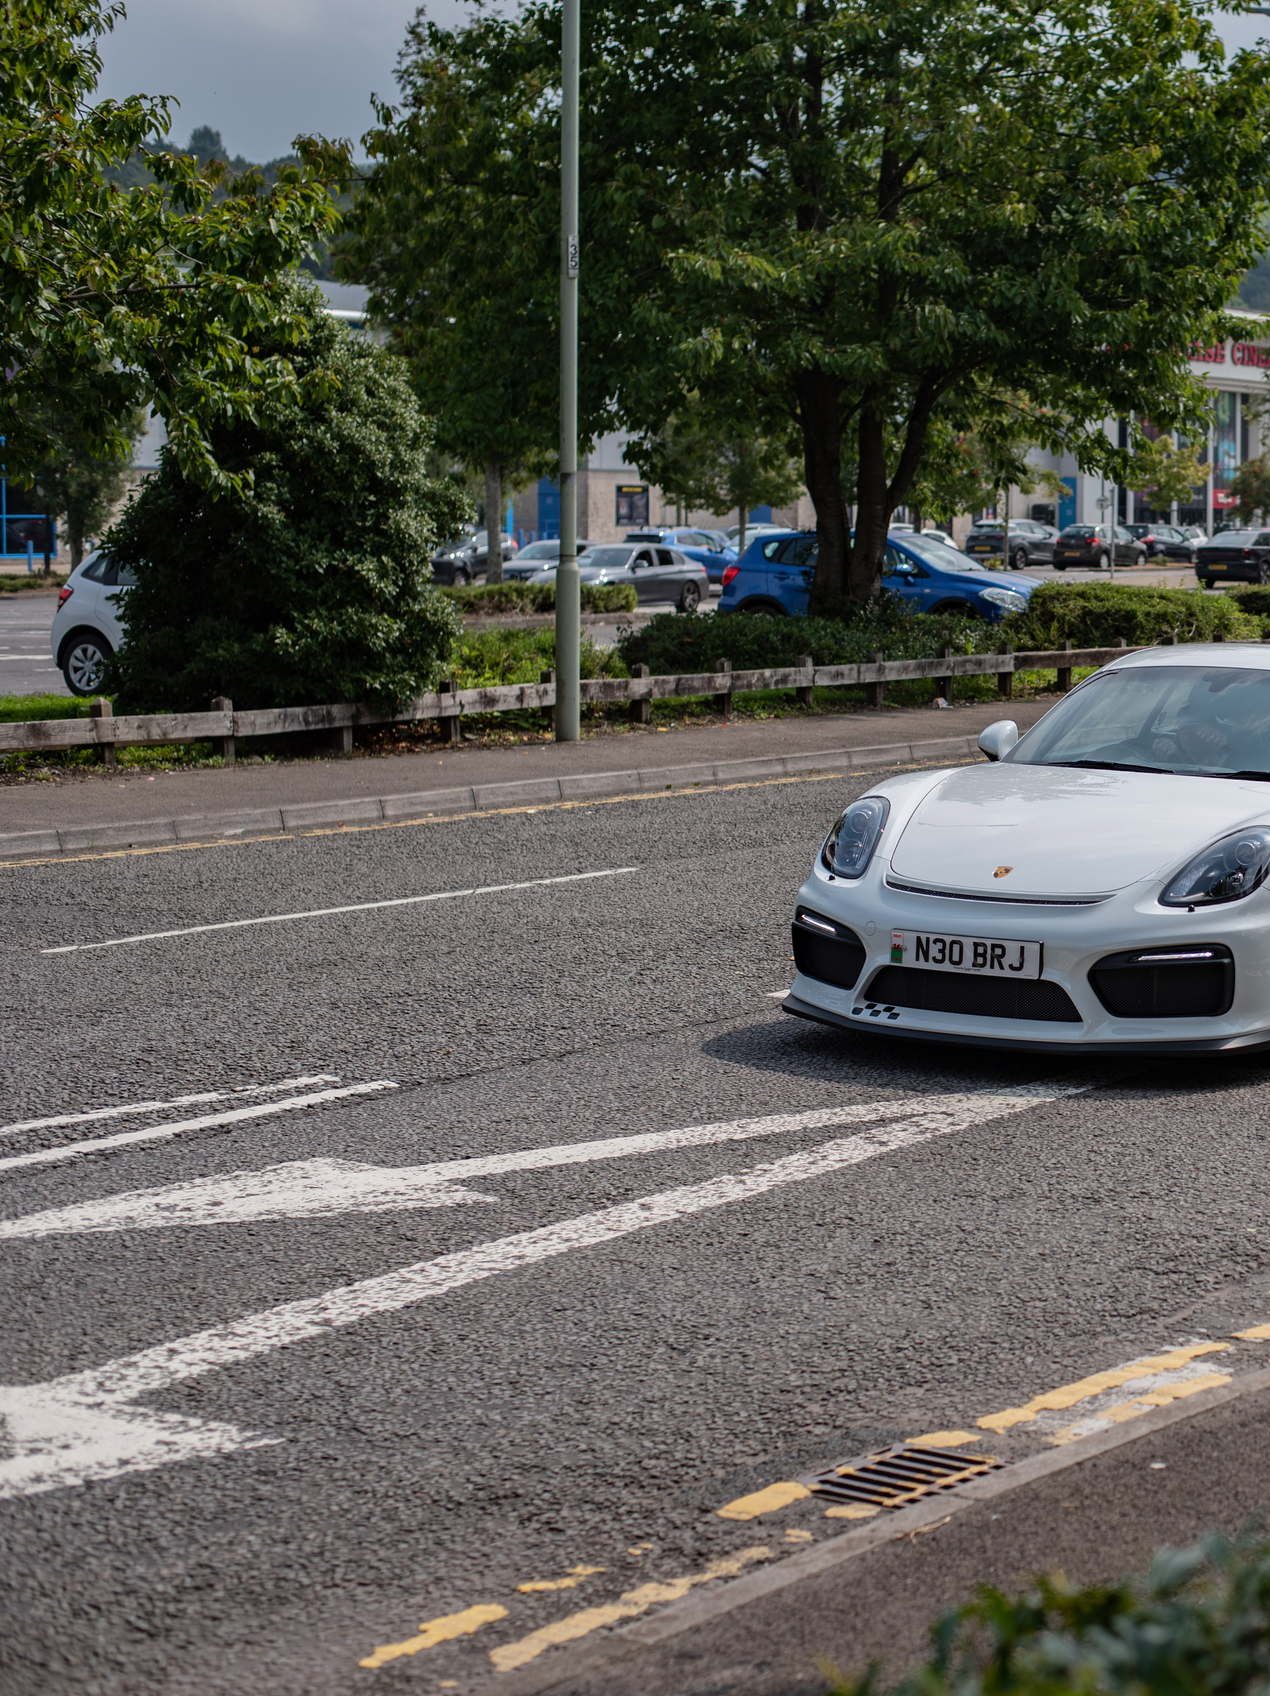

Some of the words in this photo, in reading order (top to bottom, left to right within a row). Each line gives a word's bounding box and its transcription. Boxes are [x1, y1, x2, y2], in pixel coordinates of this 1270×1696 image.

[570, 244, 578, 268] 35
[915, 935, 963, 966] N30
[972, 941, 1025, 972] BRJ
